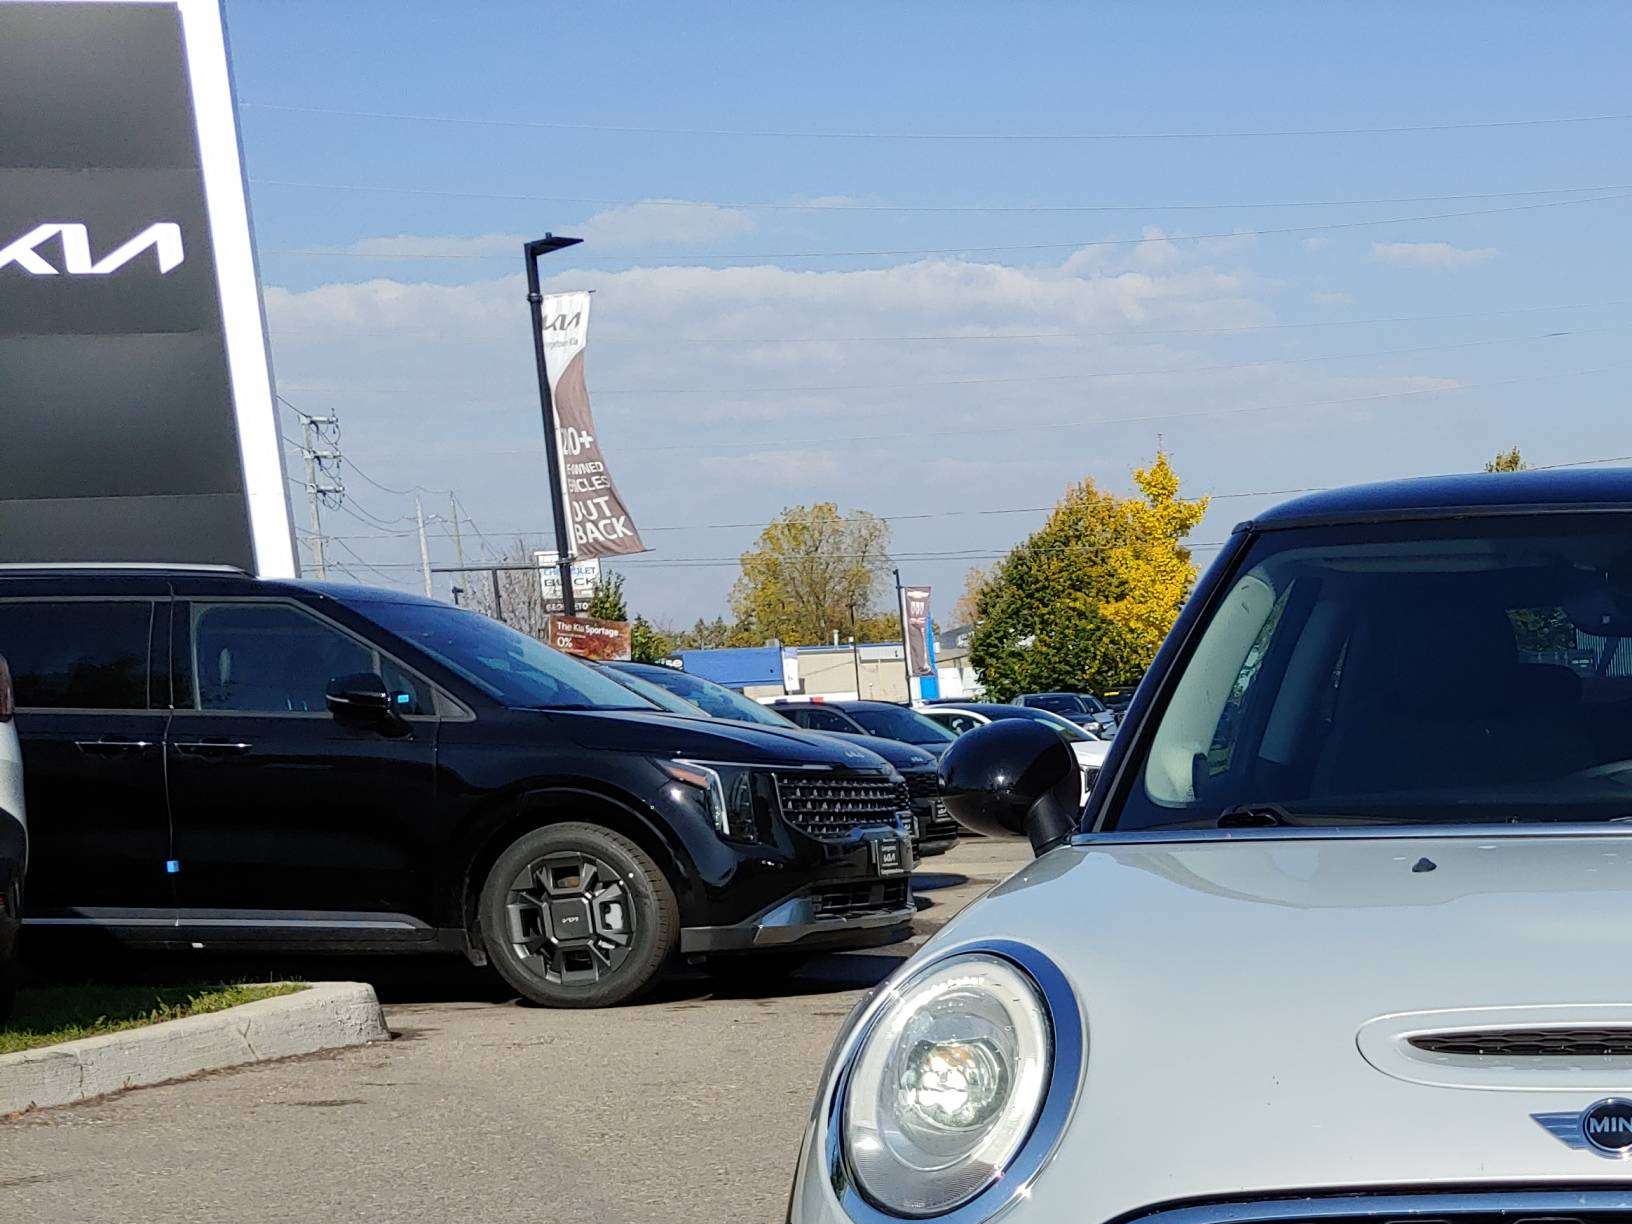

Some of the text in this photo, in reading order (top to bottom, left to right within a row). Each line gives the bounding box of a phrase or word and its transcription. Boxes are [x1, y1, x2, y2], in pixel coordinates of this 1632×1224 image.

[574, 515, 633, 544] BACK
[544, 578, 597, 587] BUCK
[557, 621, 572, 632] The
[585, 624, 619, 638] Sportage
[556, 636, 574, 648] 0%
